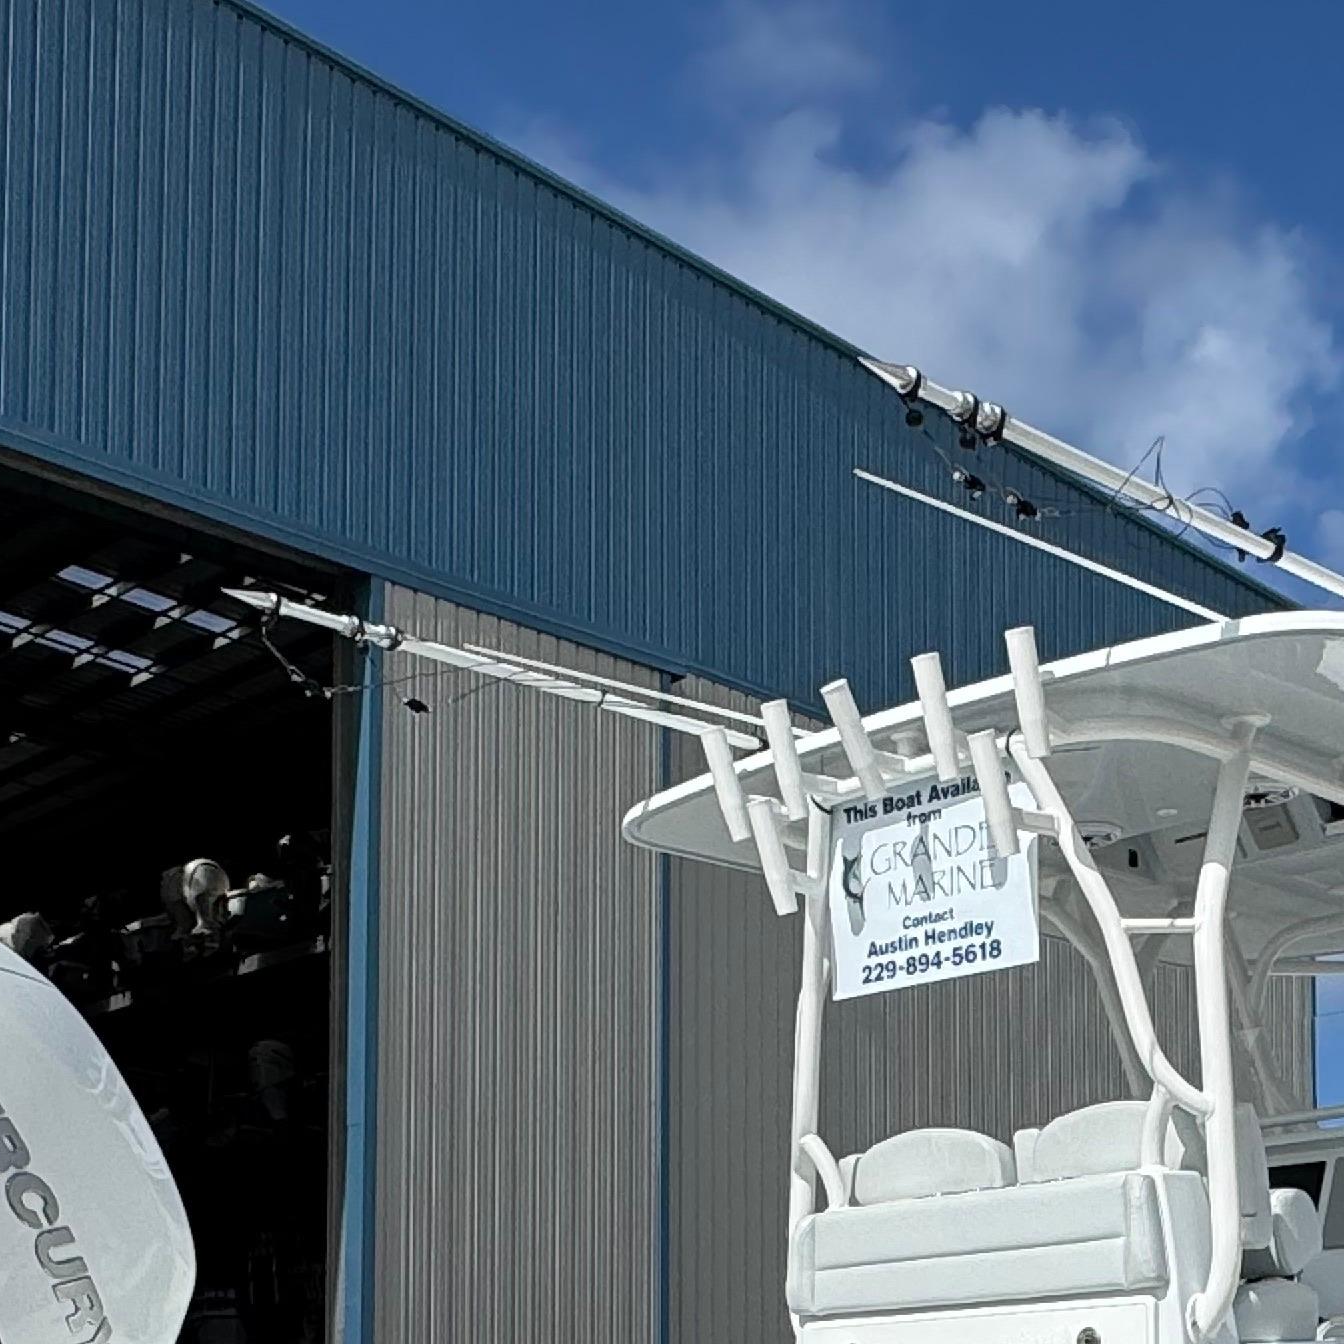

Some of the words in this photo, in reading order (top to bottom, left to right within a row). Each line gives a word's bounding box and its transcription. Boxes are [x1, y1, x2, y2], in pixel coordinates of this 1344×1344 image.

[843, 803, 877, 824] This
[882, 790, 922, 815] Boat
[906, 808, 942, 827] from
[888, 858, 1001, 908] MARINE
[902, 907, 954, 930] Contact
[867, 935, 919, 958] Austin
[923, 920, 995, 946] Hendley
[862, 939, 1002, 985] 229-894-5618
